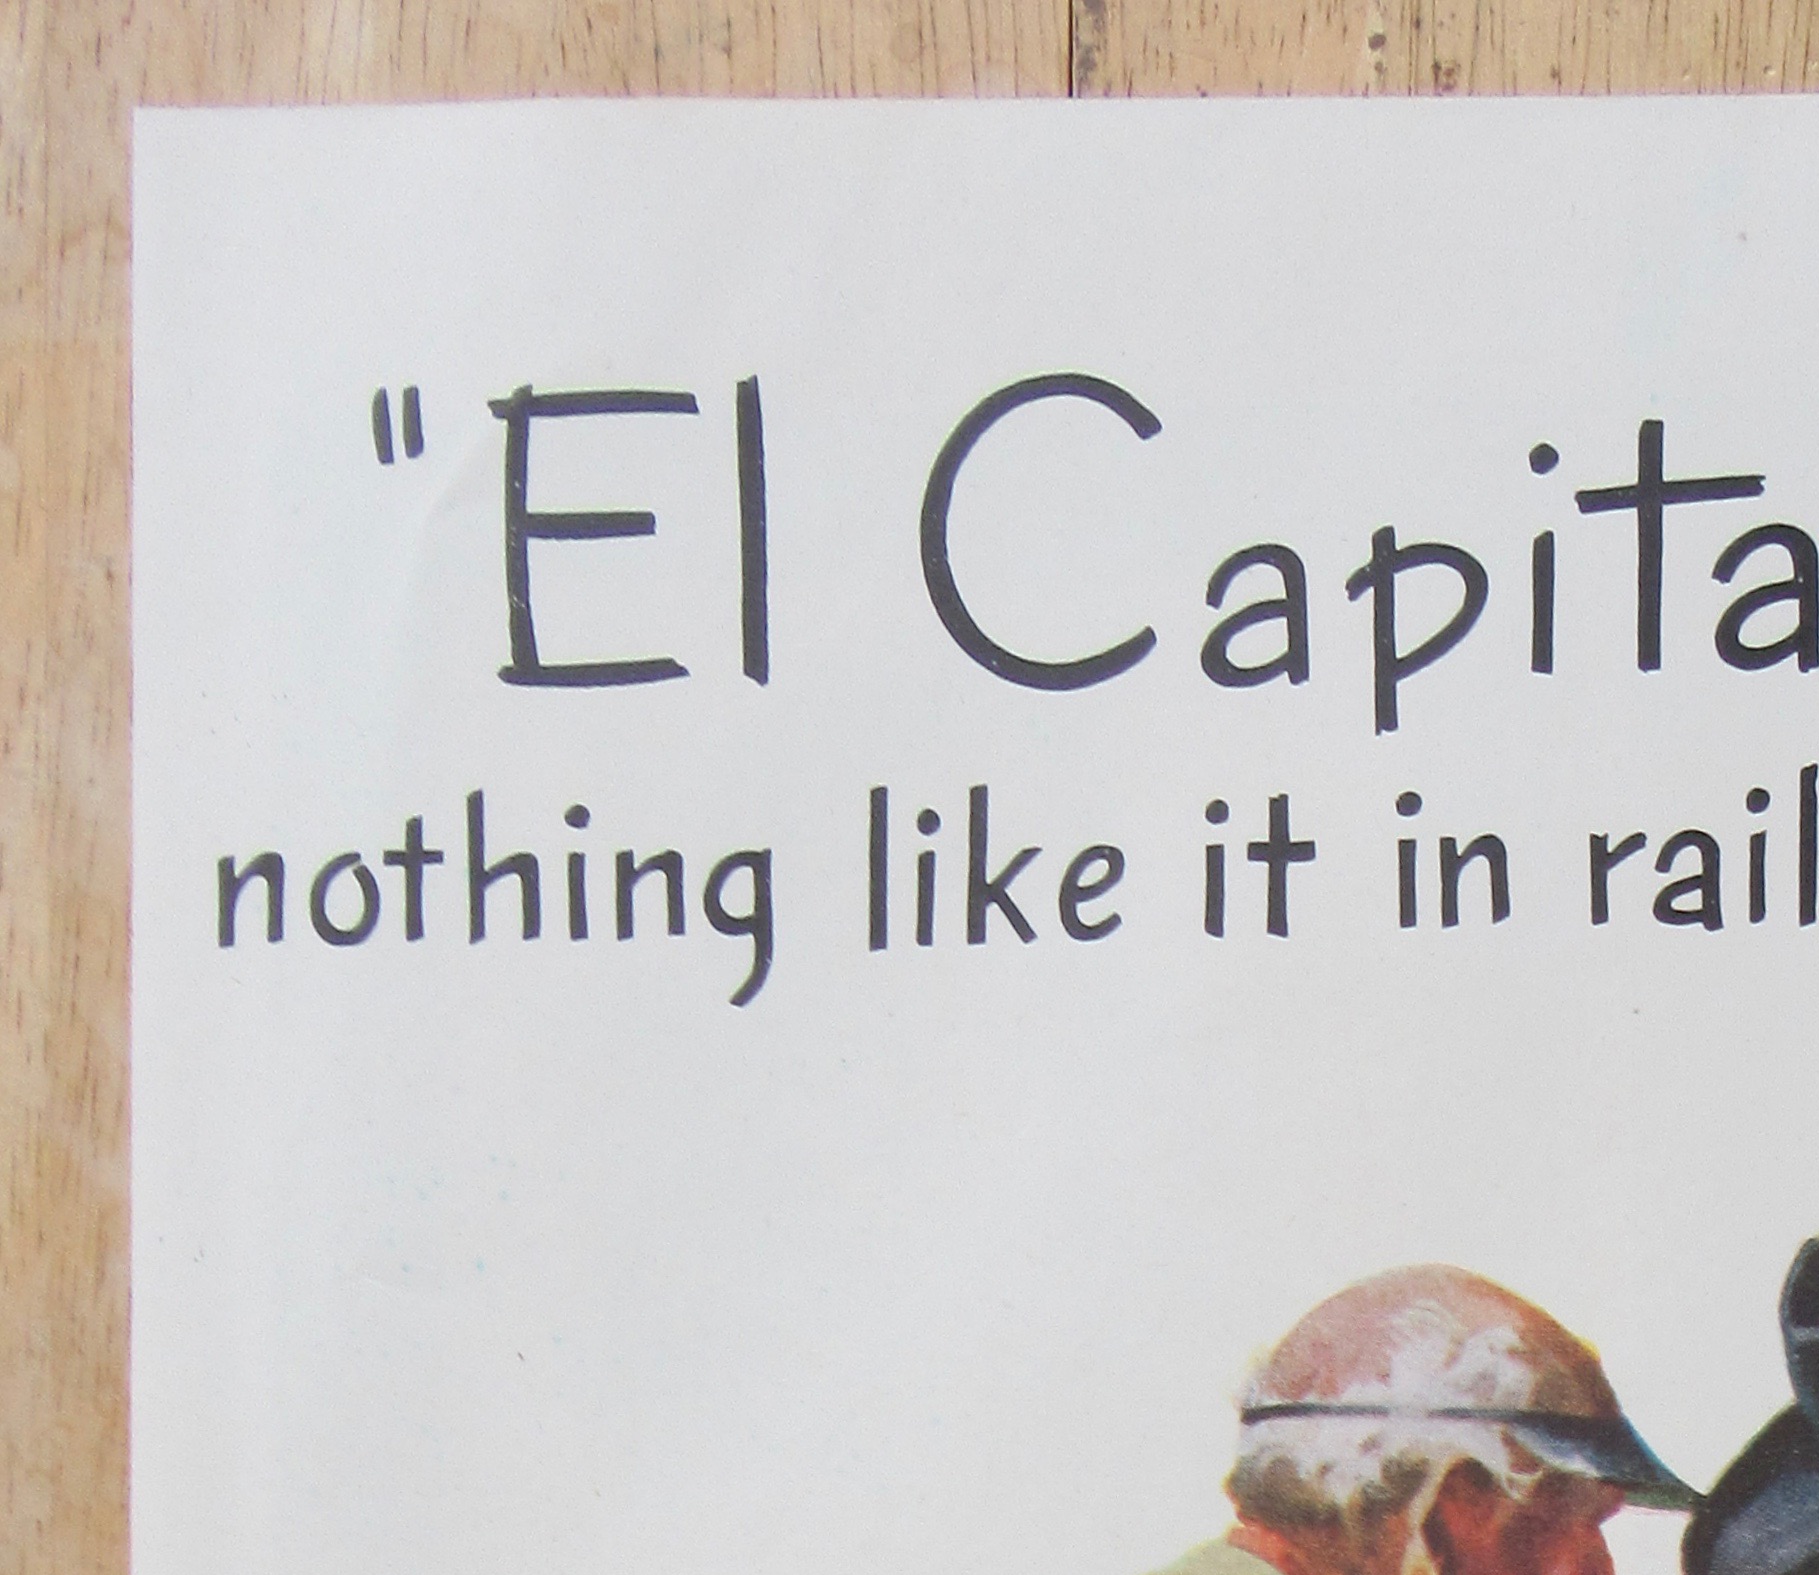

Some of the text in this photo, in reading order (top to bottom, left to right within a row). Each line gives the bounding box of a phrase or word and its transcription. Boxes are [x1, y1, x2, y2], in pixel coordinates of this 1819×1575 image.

[220, 792, 773, 1007] nothing
[871, 787, 1125, 951] like
[1206, 795, 1316, 938] it
[1397, 793, 1511, 928] in
